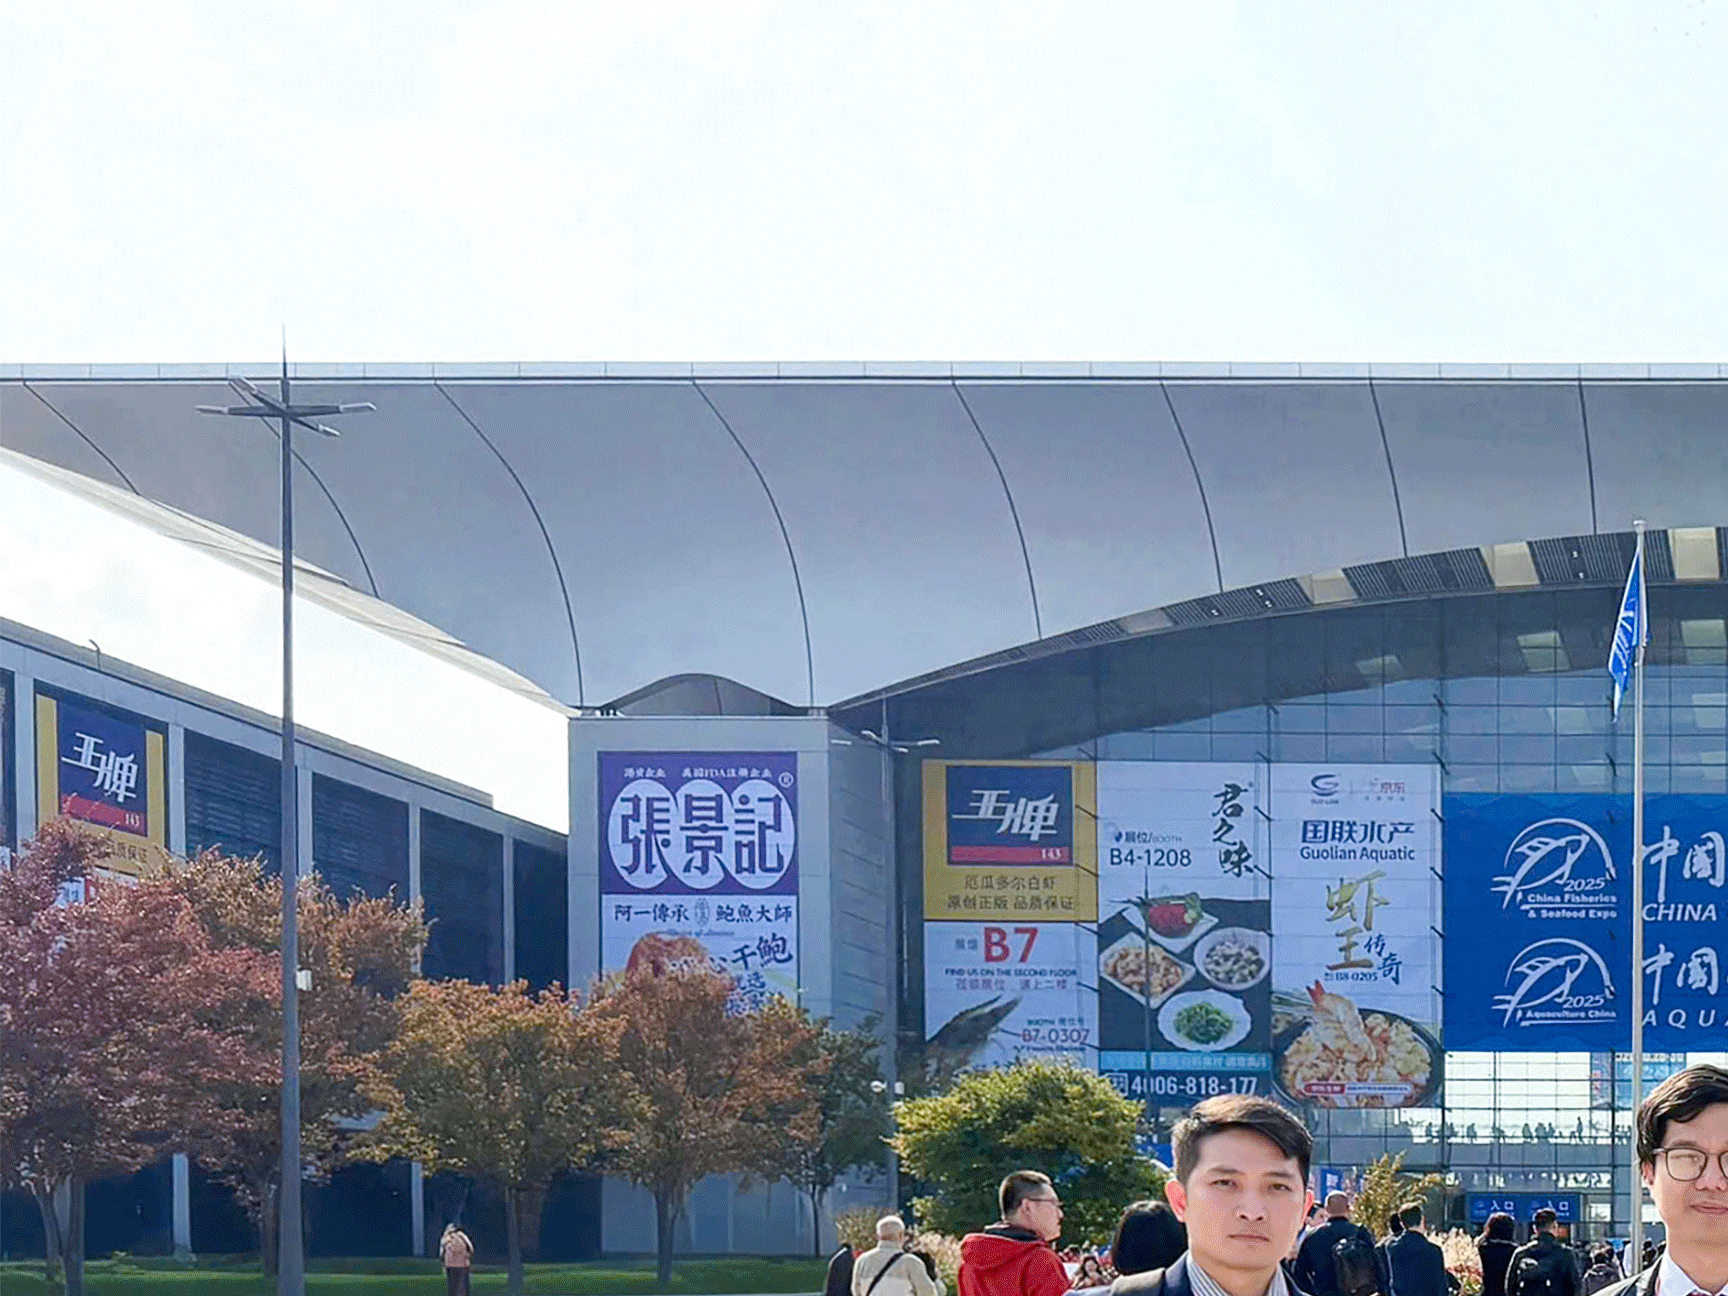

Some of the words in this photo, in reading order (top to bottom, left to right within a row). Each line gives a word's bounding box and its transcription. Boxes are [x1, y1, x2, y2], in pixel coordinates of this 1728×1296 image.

[619, 793, 786, 875] 張景記
[1301, 819, 1416, 845] 国联水产
[1110, 847, 1192, 867] B4-1208
[1300, 846, 1357, 861] Guolian
[1359, 846, 1416, 863] Aquatic
[1563, 877, 1606, 892] 2025
[1527, 893, 1562, 903] China
[1563, 893, 1618, 903] Fisheries
[1527, 910, 1537, 919] &
[1540, 909, 1586, 919] Seafood
[1588, 909, 1618, 920] Expo
[1642, 903, 1718, 922] CHINA
[984, 926, 1040, 964] B7
[1562, 995, 1606, 1010] 2025
[1526, 1009, 1586, 1019] Aquaculture
[1587, 1009, 1617, 1019] China
